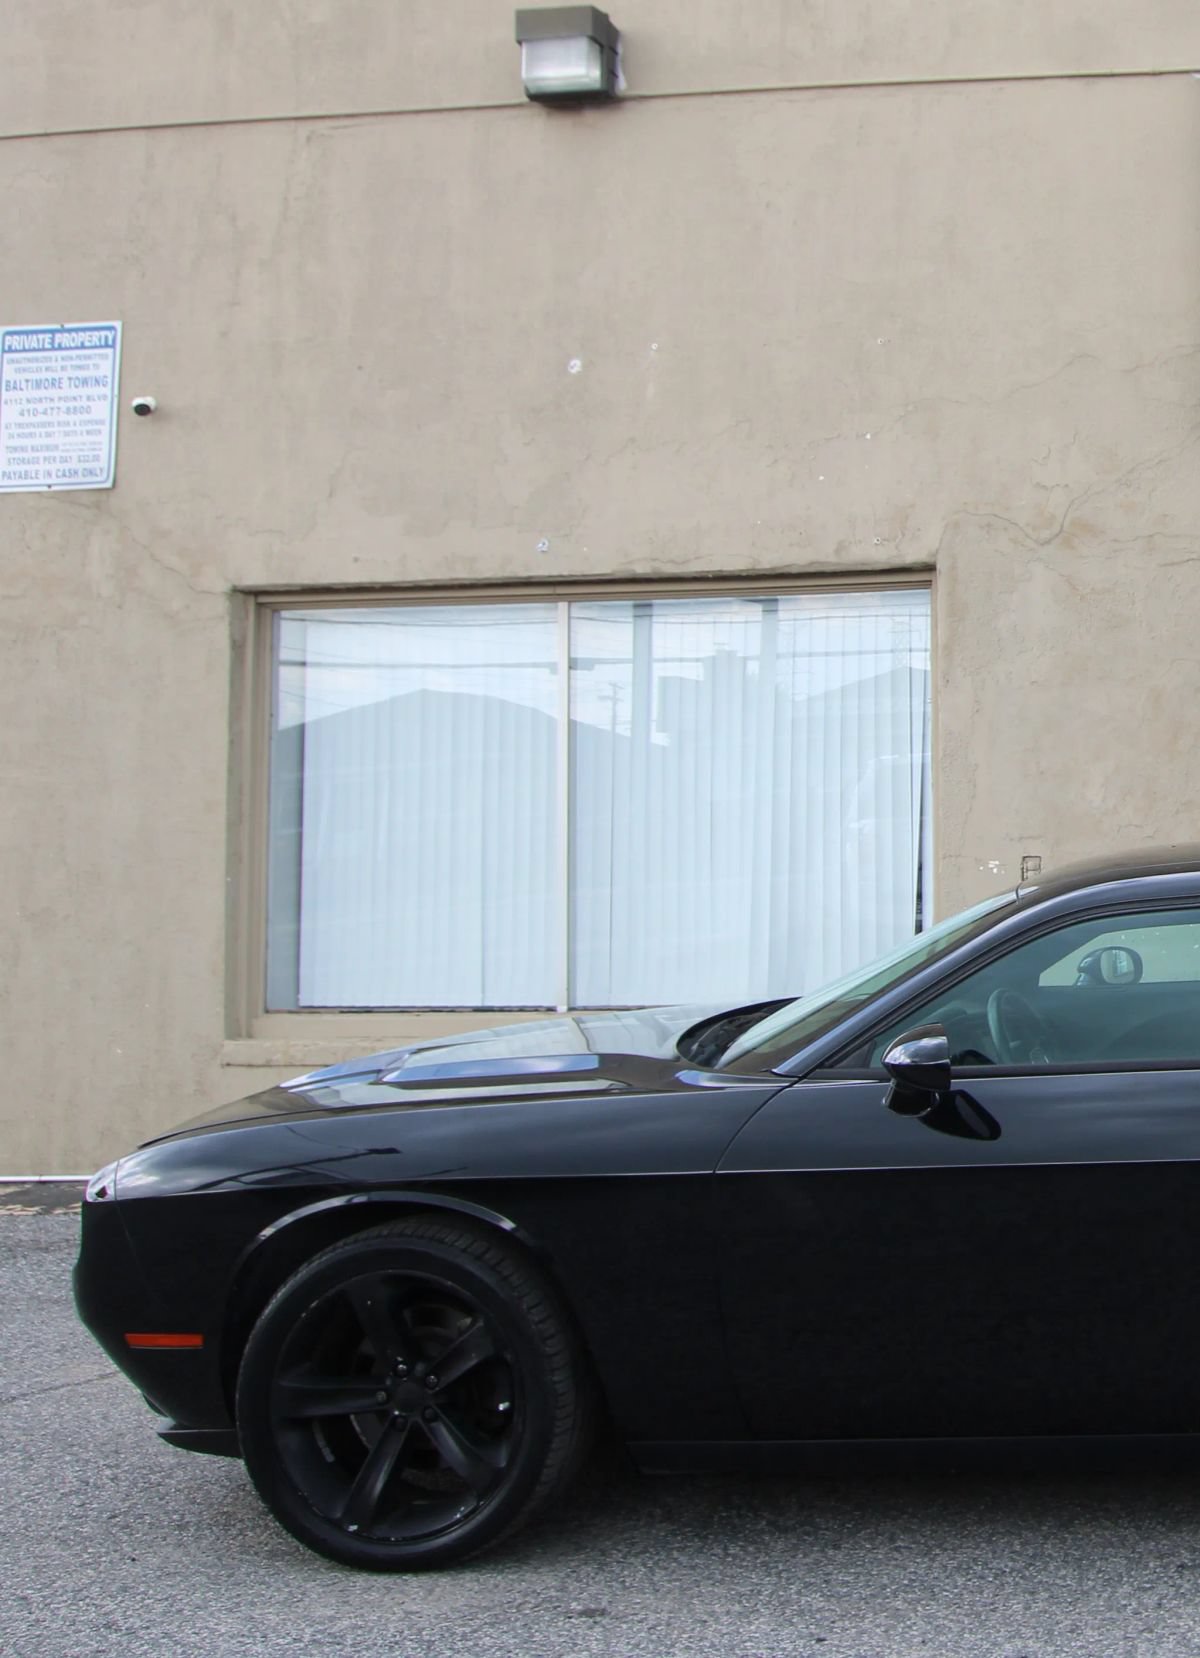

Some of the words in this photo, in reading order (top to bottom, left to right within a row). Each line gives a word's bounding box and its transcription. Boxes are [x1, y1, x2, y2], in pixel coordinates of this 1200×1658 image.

[4, 333, 52, 351] PRIVATE
[54, 329, 115, 349] PROPERTY
[4, 376, 64, 392] BALTIMORE
[66, 374, 109, 389] TOWING
[25, 396, 55, 404] NORTH
[57, 395, 83, 403] POINT
[86, 394, 108, 402] BLVD
[7, 456, 41, 466] STORAGE
[42, 455, 57, 465] PER
[59, 455, 73, 464] DAY
[1, 469, 40, 481] PAYABLE
[43, 468, 53, 480] IN
[55, 467, 80, 479] CASH
[82, 466, 104, 478] ONLY
